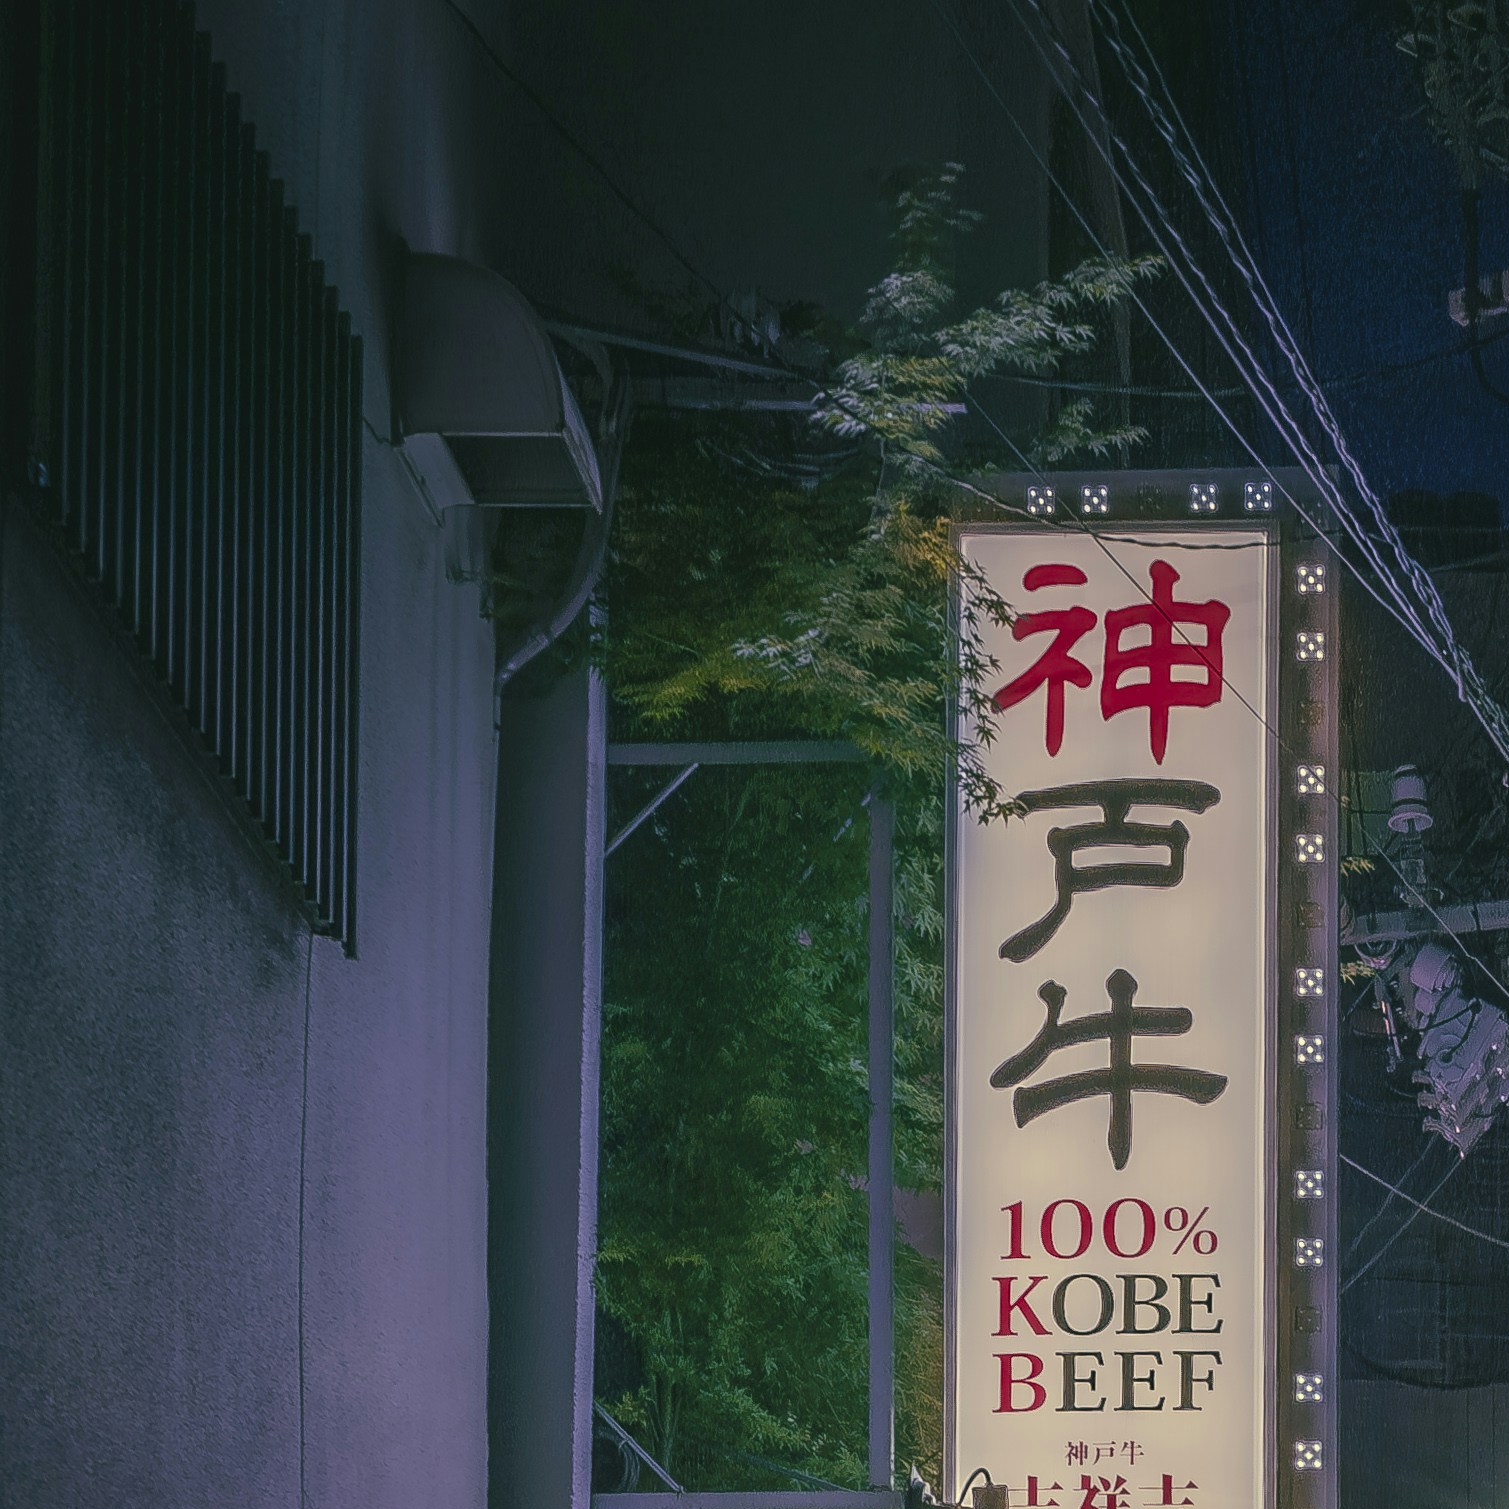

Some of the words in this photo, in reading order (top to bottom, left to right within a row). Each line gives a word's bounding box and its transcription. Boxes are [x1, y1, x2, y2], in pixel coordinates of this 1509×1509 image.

[992, 559, 1230, 1170] 神戸牛
[1000, 1198, 1219, 1260] 100%
[990, 1272, 1224, 1337] KOBE
[991, 1351, 1224, 1413] BEEF
[1065, 1439, 1145, 1466] 神戸牛
